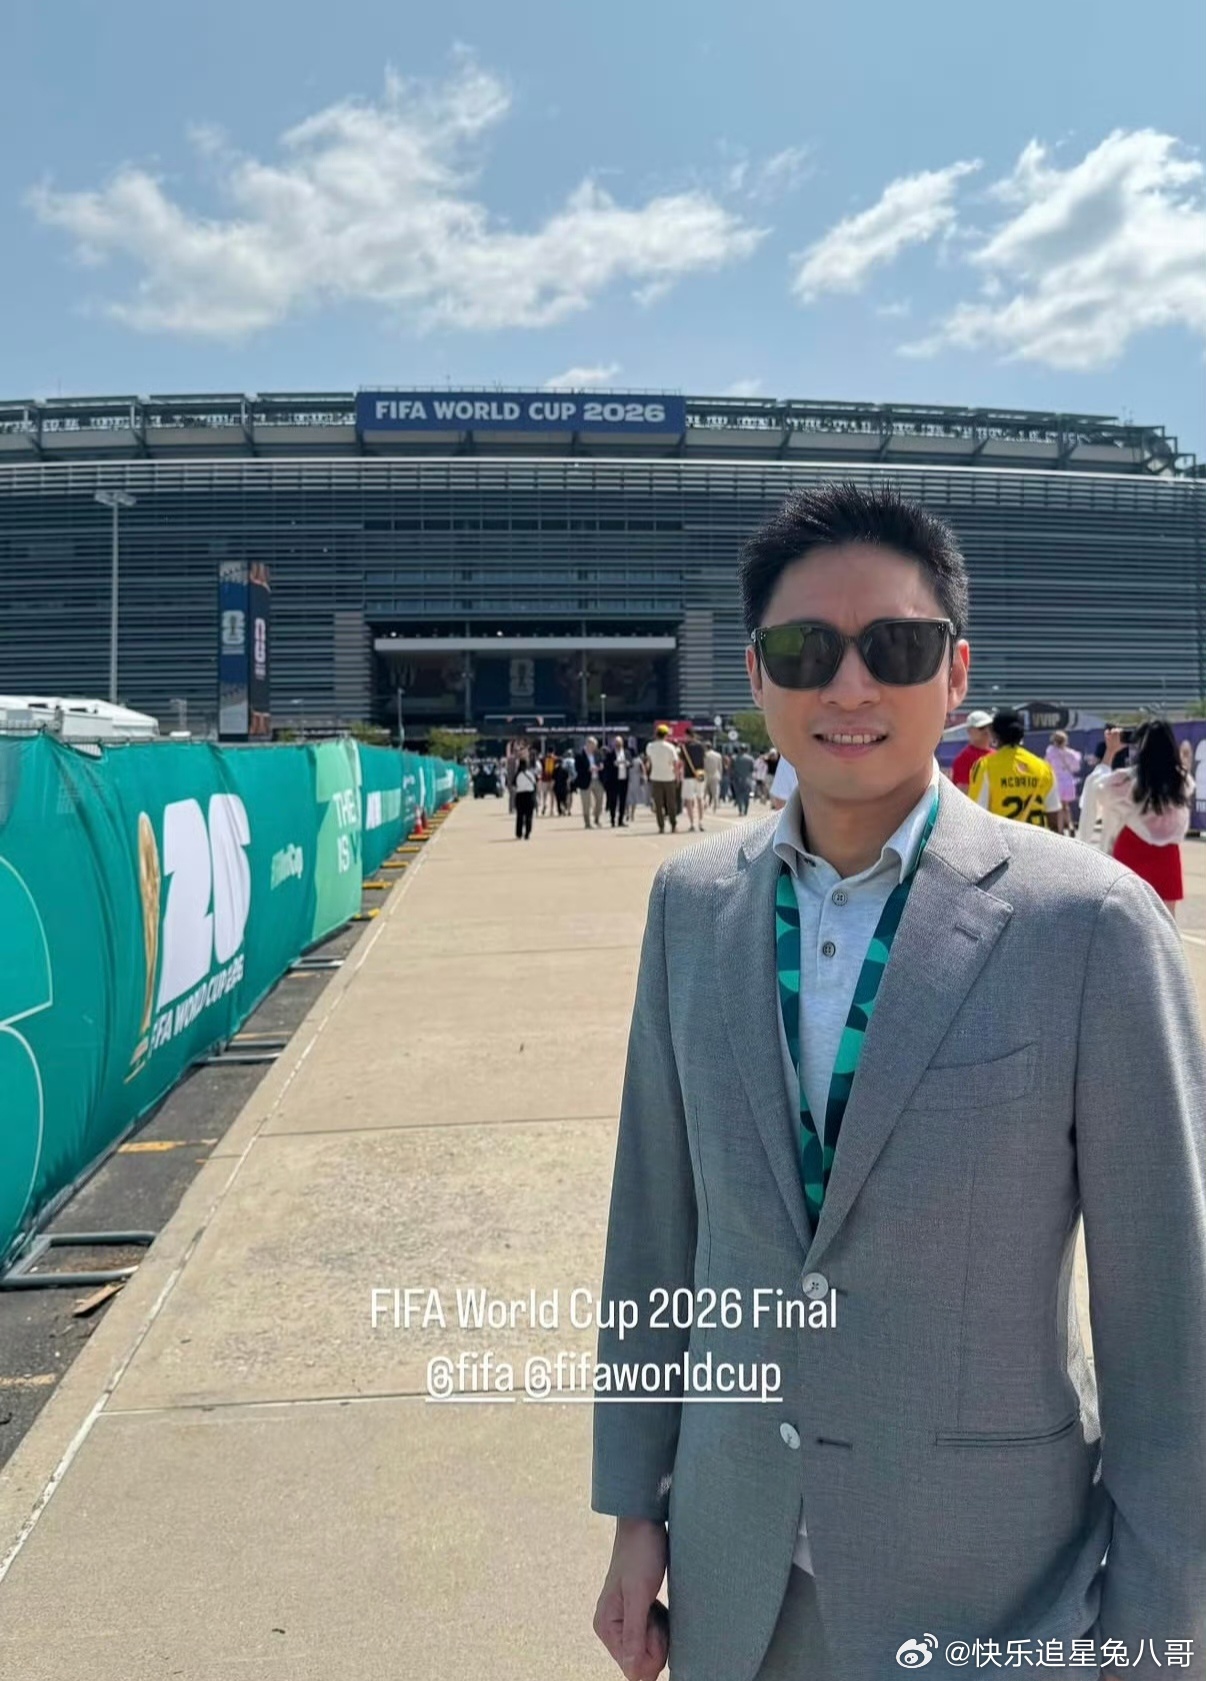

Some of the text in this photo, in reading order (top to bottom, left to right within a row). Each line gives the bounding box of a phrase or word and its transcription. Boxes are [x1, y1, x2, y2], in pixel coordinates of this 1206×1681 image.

[375, 401, 666, 422] FIFA WORLD CUP 2026
